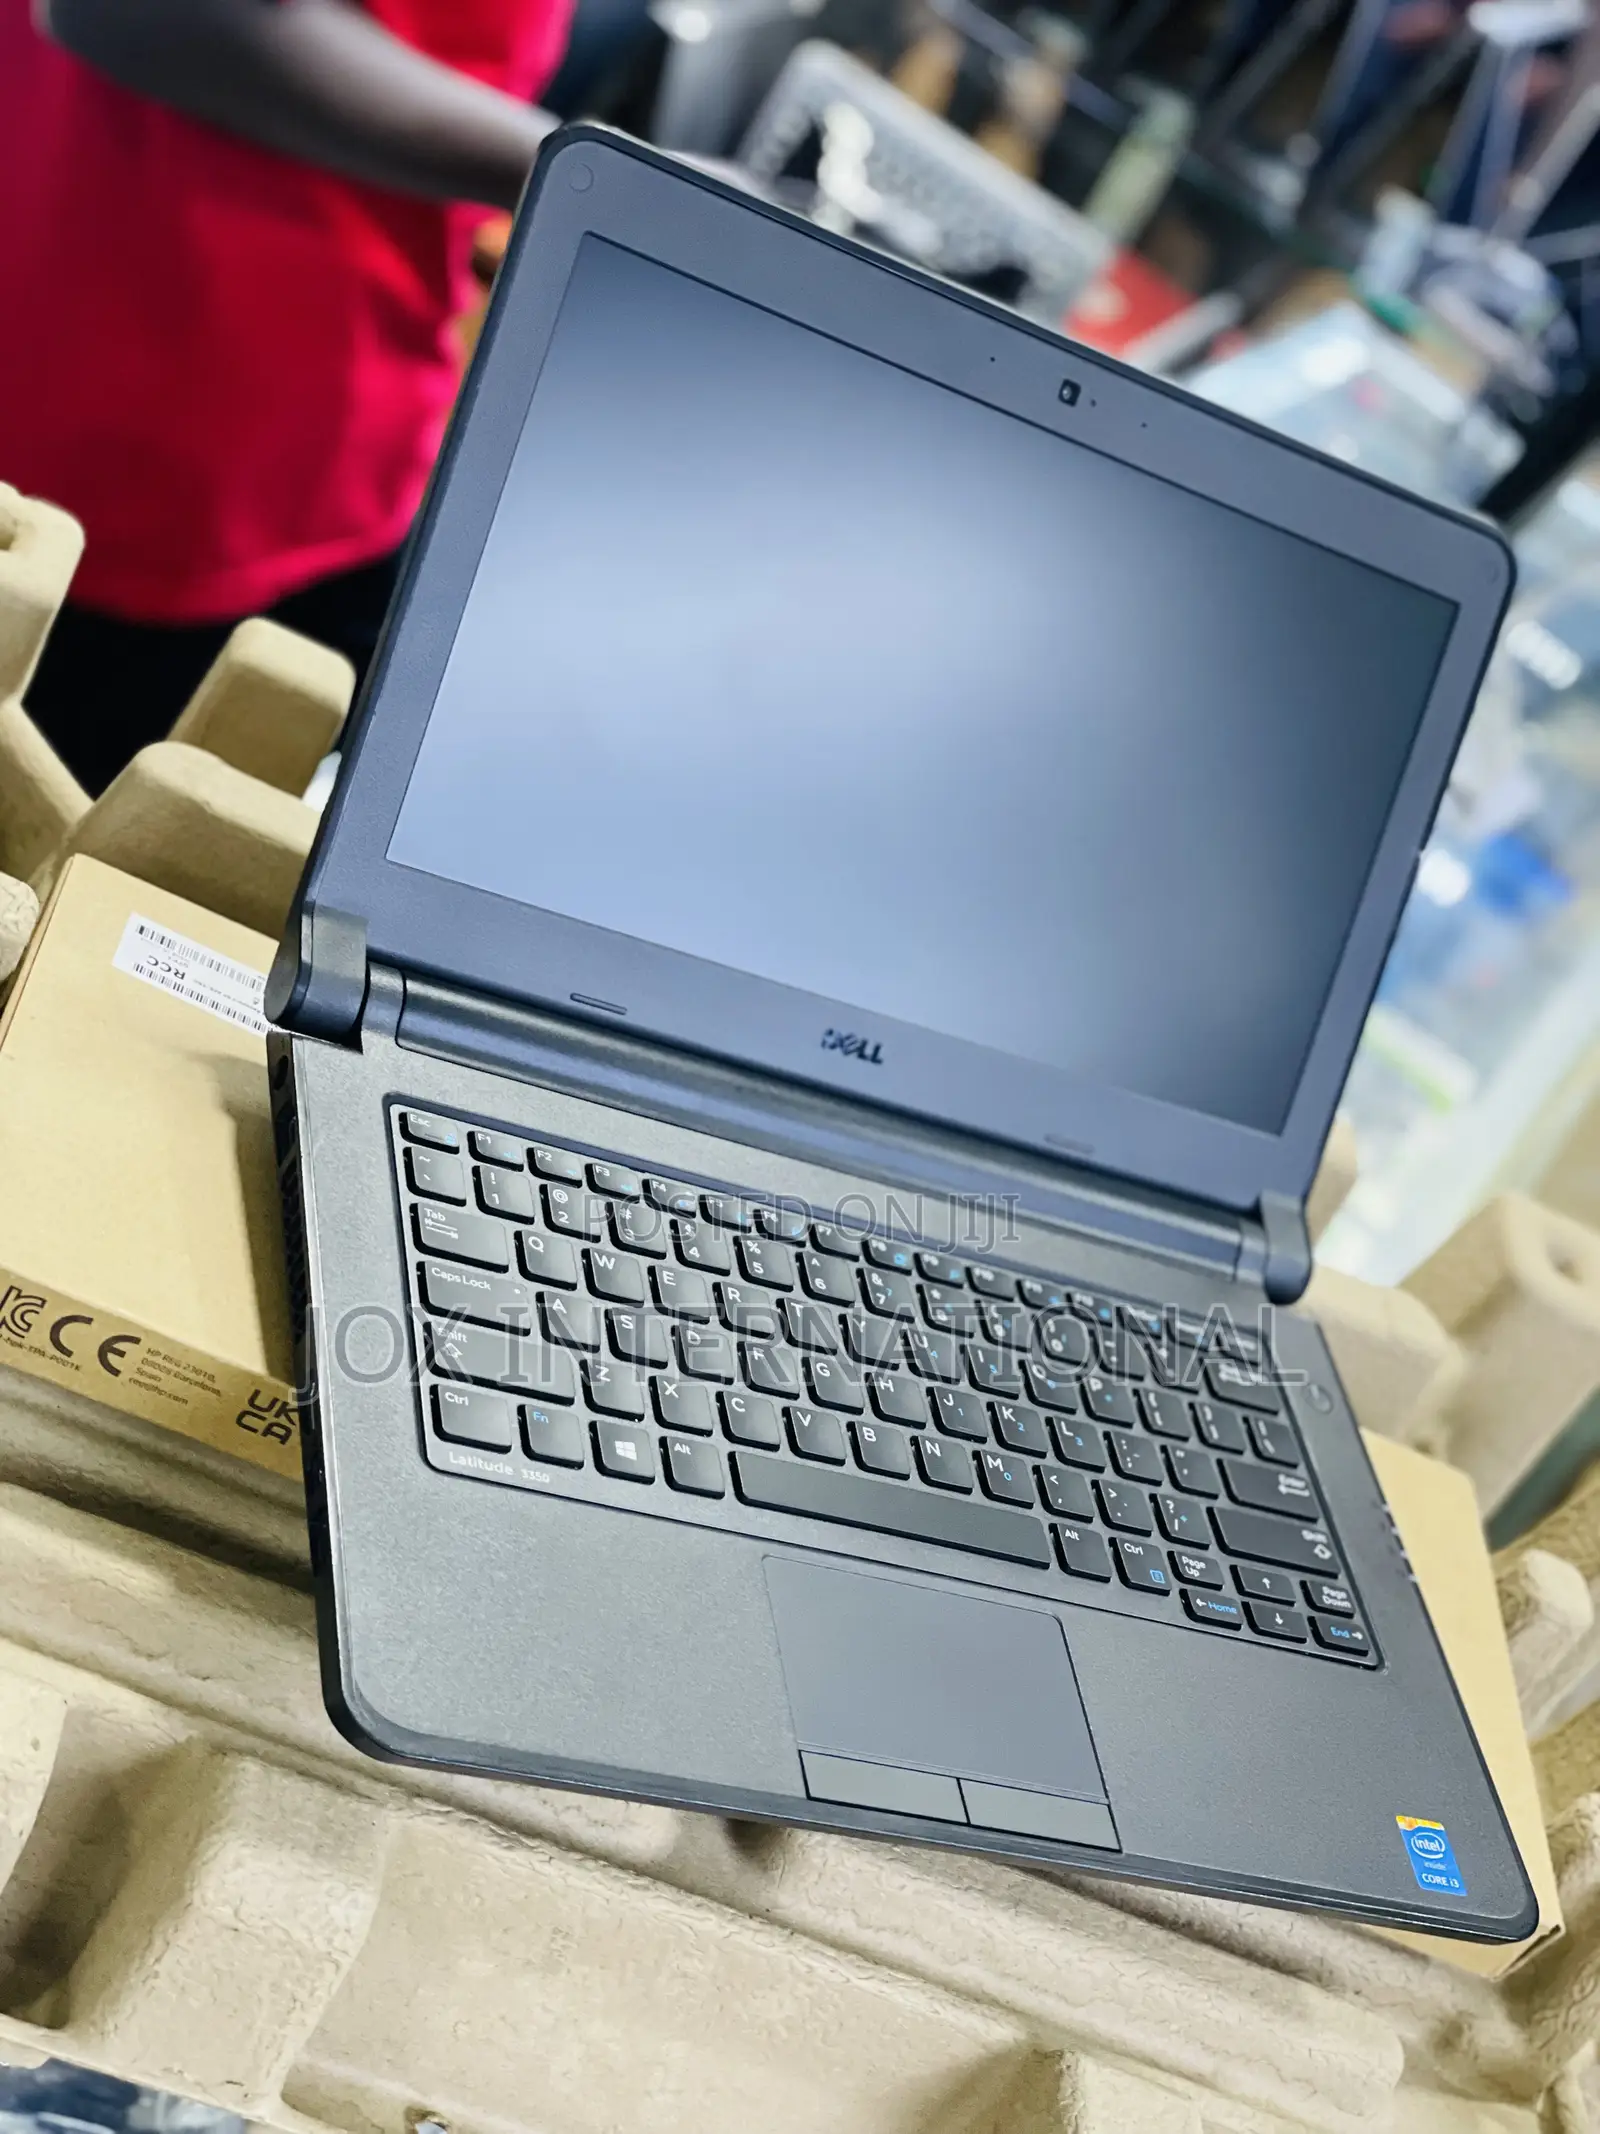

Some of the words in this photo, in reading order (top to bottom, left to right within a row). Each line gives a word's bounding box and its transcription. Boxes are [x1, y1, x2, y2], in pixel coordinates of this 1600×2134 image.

[146, 954, 186, 980] RCC
[821, 1028, 883, 1065] DELL
[410, 1114, 431, 1127] Esc
[478, 1133, 492, 1144] F1
[537, 1150, 552, 1162] F2
[596, 1166, 610, 1177] F3
[652, 1180, 667, 1193] F4
[492, 1193, 499, 1204] 1
[553, 1189, 568, 1204] @
[424, 1208, 446, 1222] Tab
[559, 1211, 570, 1224] 2
[528, 1236, 544, 1252] Q
[746, 1240, 761, 1255] %
[689, 1246, 700, 1258] 4
[594, 1252, 615, 1270] W
[752, 1262, 764, 1275] 5
[431, 1267, 461, 1283] Caps
[463, 1276, 491, 1291] Lock
[662, 1271, 676, 1286] E
[814, 1278, 827, 1290] 6
[871, 1272, 884, 1286] &
[727, 1287, 742, 1303] R
[876, 1292, 886, 1305] 7
[553, 1299, 567, 1314] A
[790, 1301, 804, 1318] T
[620, 1315, 634, 1330] S
[852, 1318, 866, 1333] Y
[686, 1329, 700, 1344] D
[50, 1315, 142, 1377] CE
[753, 1347, 765, 1360] F
[595, 1365, 611, 1382] Z
[816, 1362, 831, 1377] G
[663, 1381, 679, 1398] X
[879, 1377, 895, 1393] H
[444, 1392, 469, 1406] Ctrl
[731, 1397, 746, 1413] C
[943, 1393, 954, 1406] J
[533, 1411, 549, 1424] Fn
[796, 1410, 812, 1427] V
[1001, 1405, 1017, 1422] K
[862, 1426, 877, 1442] B
[1016, 1422, 1026, 1432] 2
[1060, 1421, 1074, 1437] L
[674, 1442, 692, 1455] Alt
[925, 1439, 942, 1457] N
[1075, 1436, 1084, 1446] 3
[450, 1452, 513, 1476] Latitude
[521, 1469, 550, 1483] 3350
[986, 1454, 1004, 1472] M
[1166, 1500, 1175, 1514] ?
[1065, 1528, 1080, 1541] Alt
[1123, 1543, 1144, 1556] Ctrl
[1181, 1555, 1206, 1570] Page
[1185, 1566, 1200, 1578] Up
[1207, 1601, 1237, 1615] Home
[1330, 1626, 1350, 1638] End
[1414, 1836, 1441, 1852] intel
[1422, 1873, 1449, 1886] CORE
